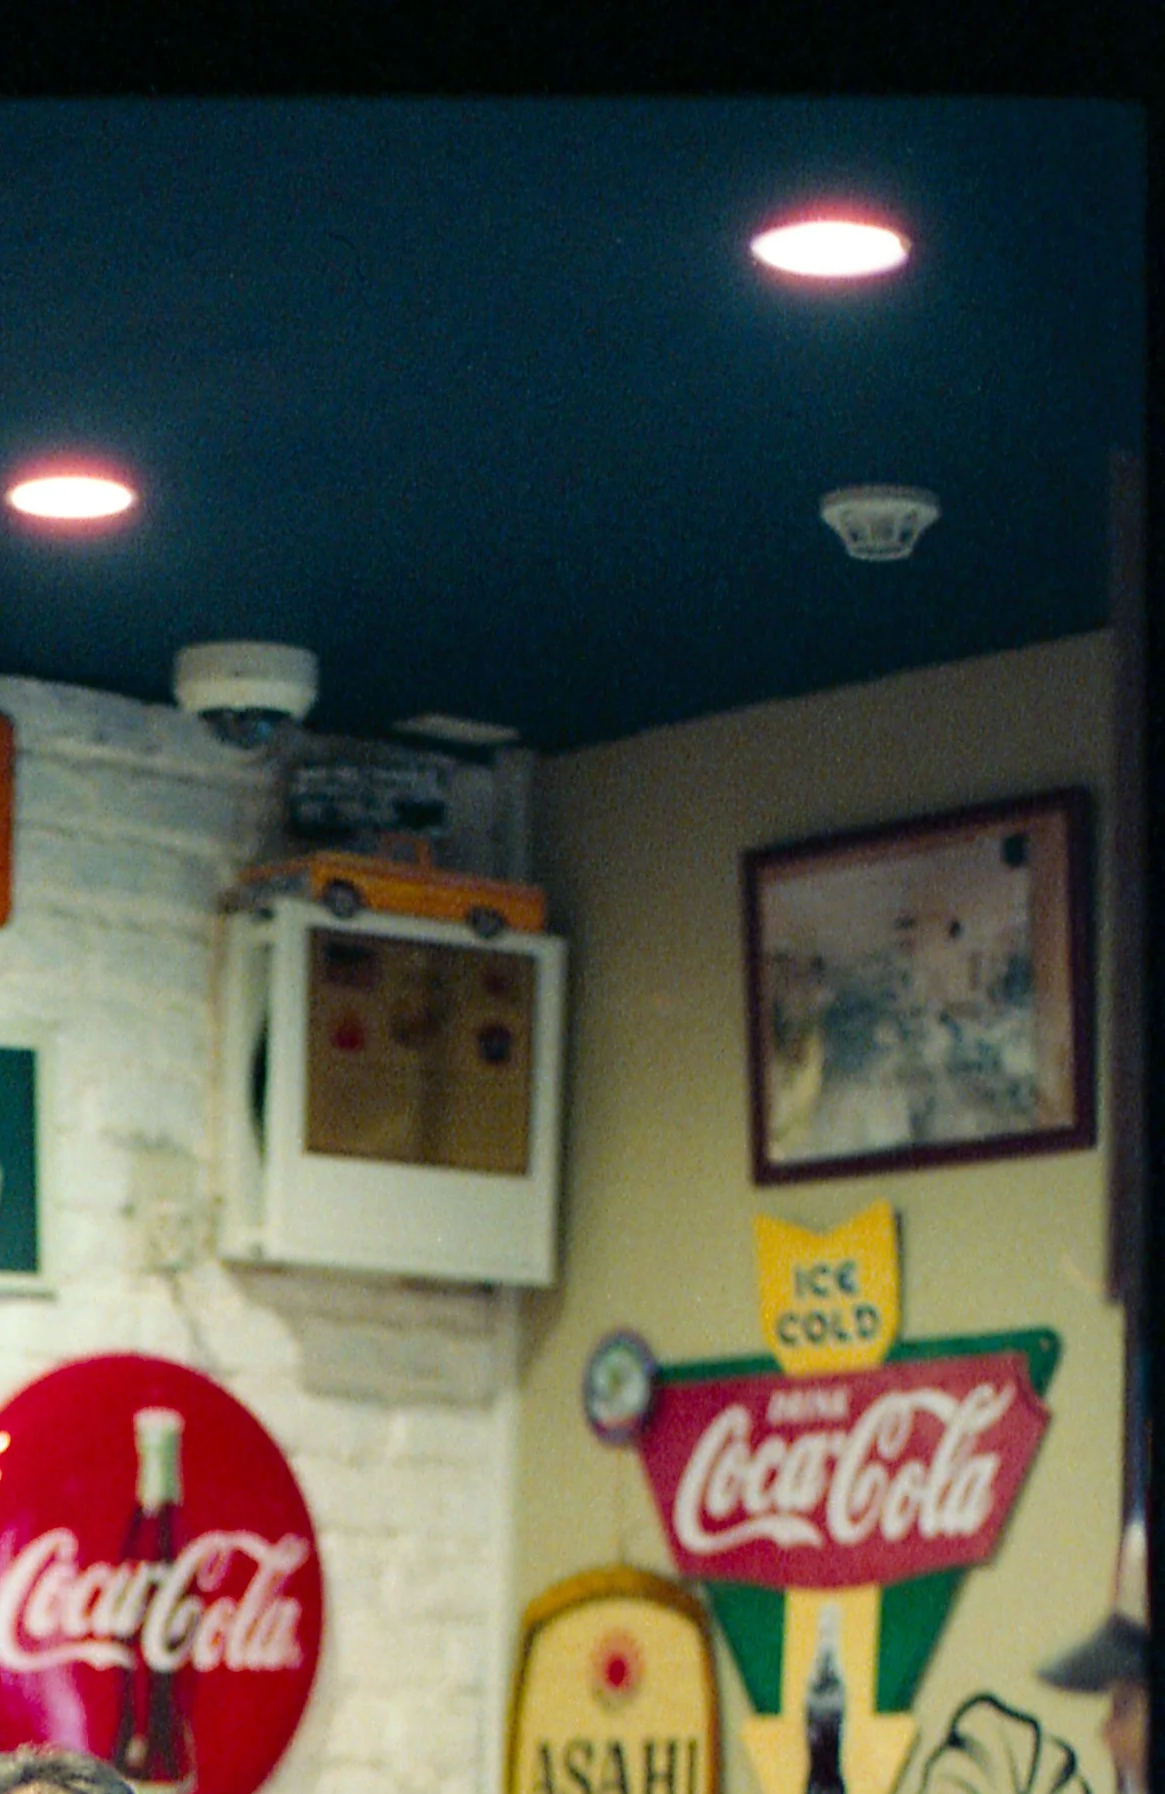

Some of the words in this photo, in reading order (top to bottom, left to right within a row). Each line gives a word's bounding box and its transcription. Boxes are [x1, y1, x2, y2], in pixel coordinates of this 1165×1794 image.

[793, 1259, 859, 1298] ICE
[776, 1303, 881, 1347] COLD
[673, 1379, 1018, 1556] Coca-Cola
